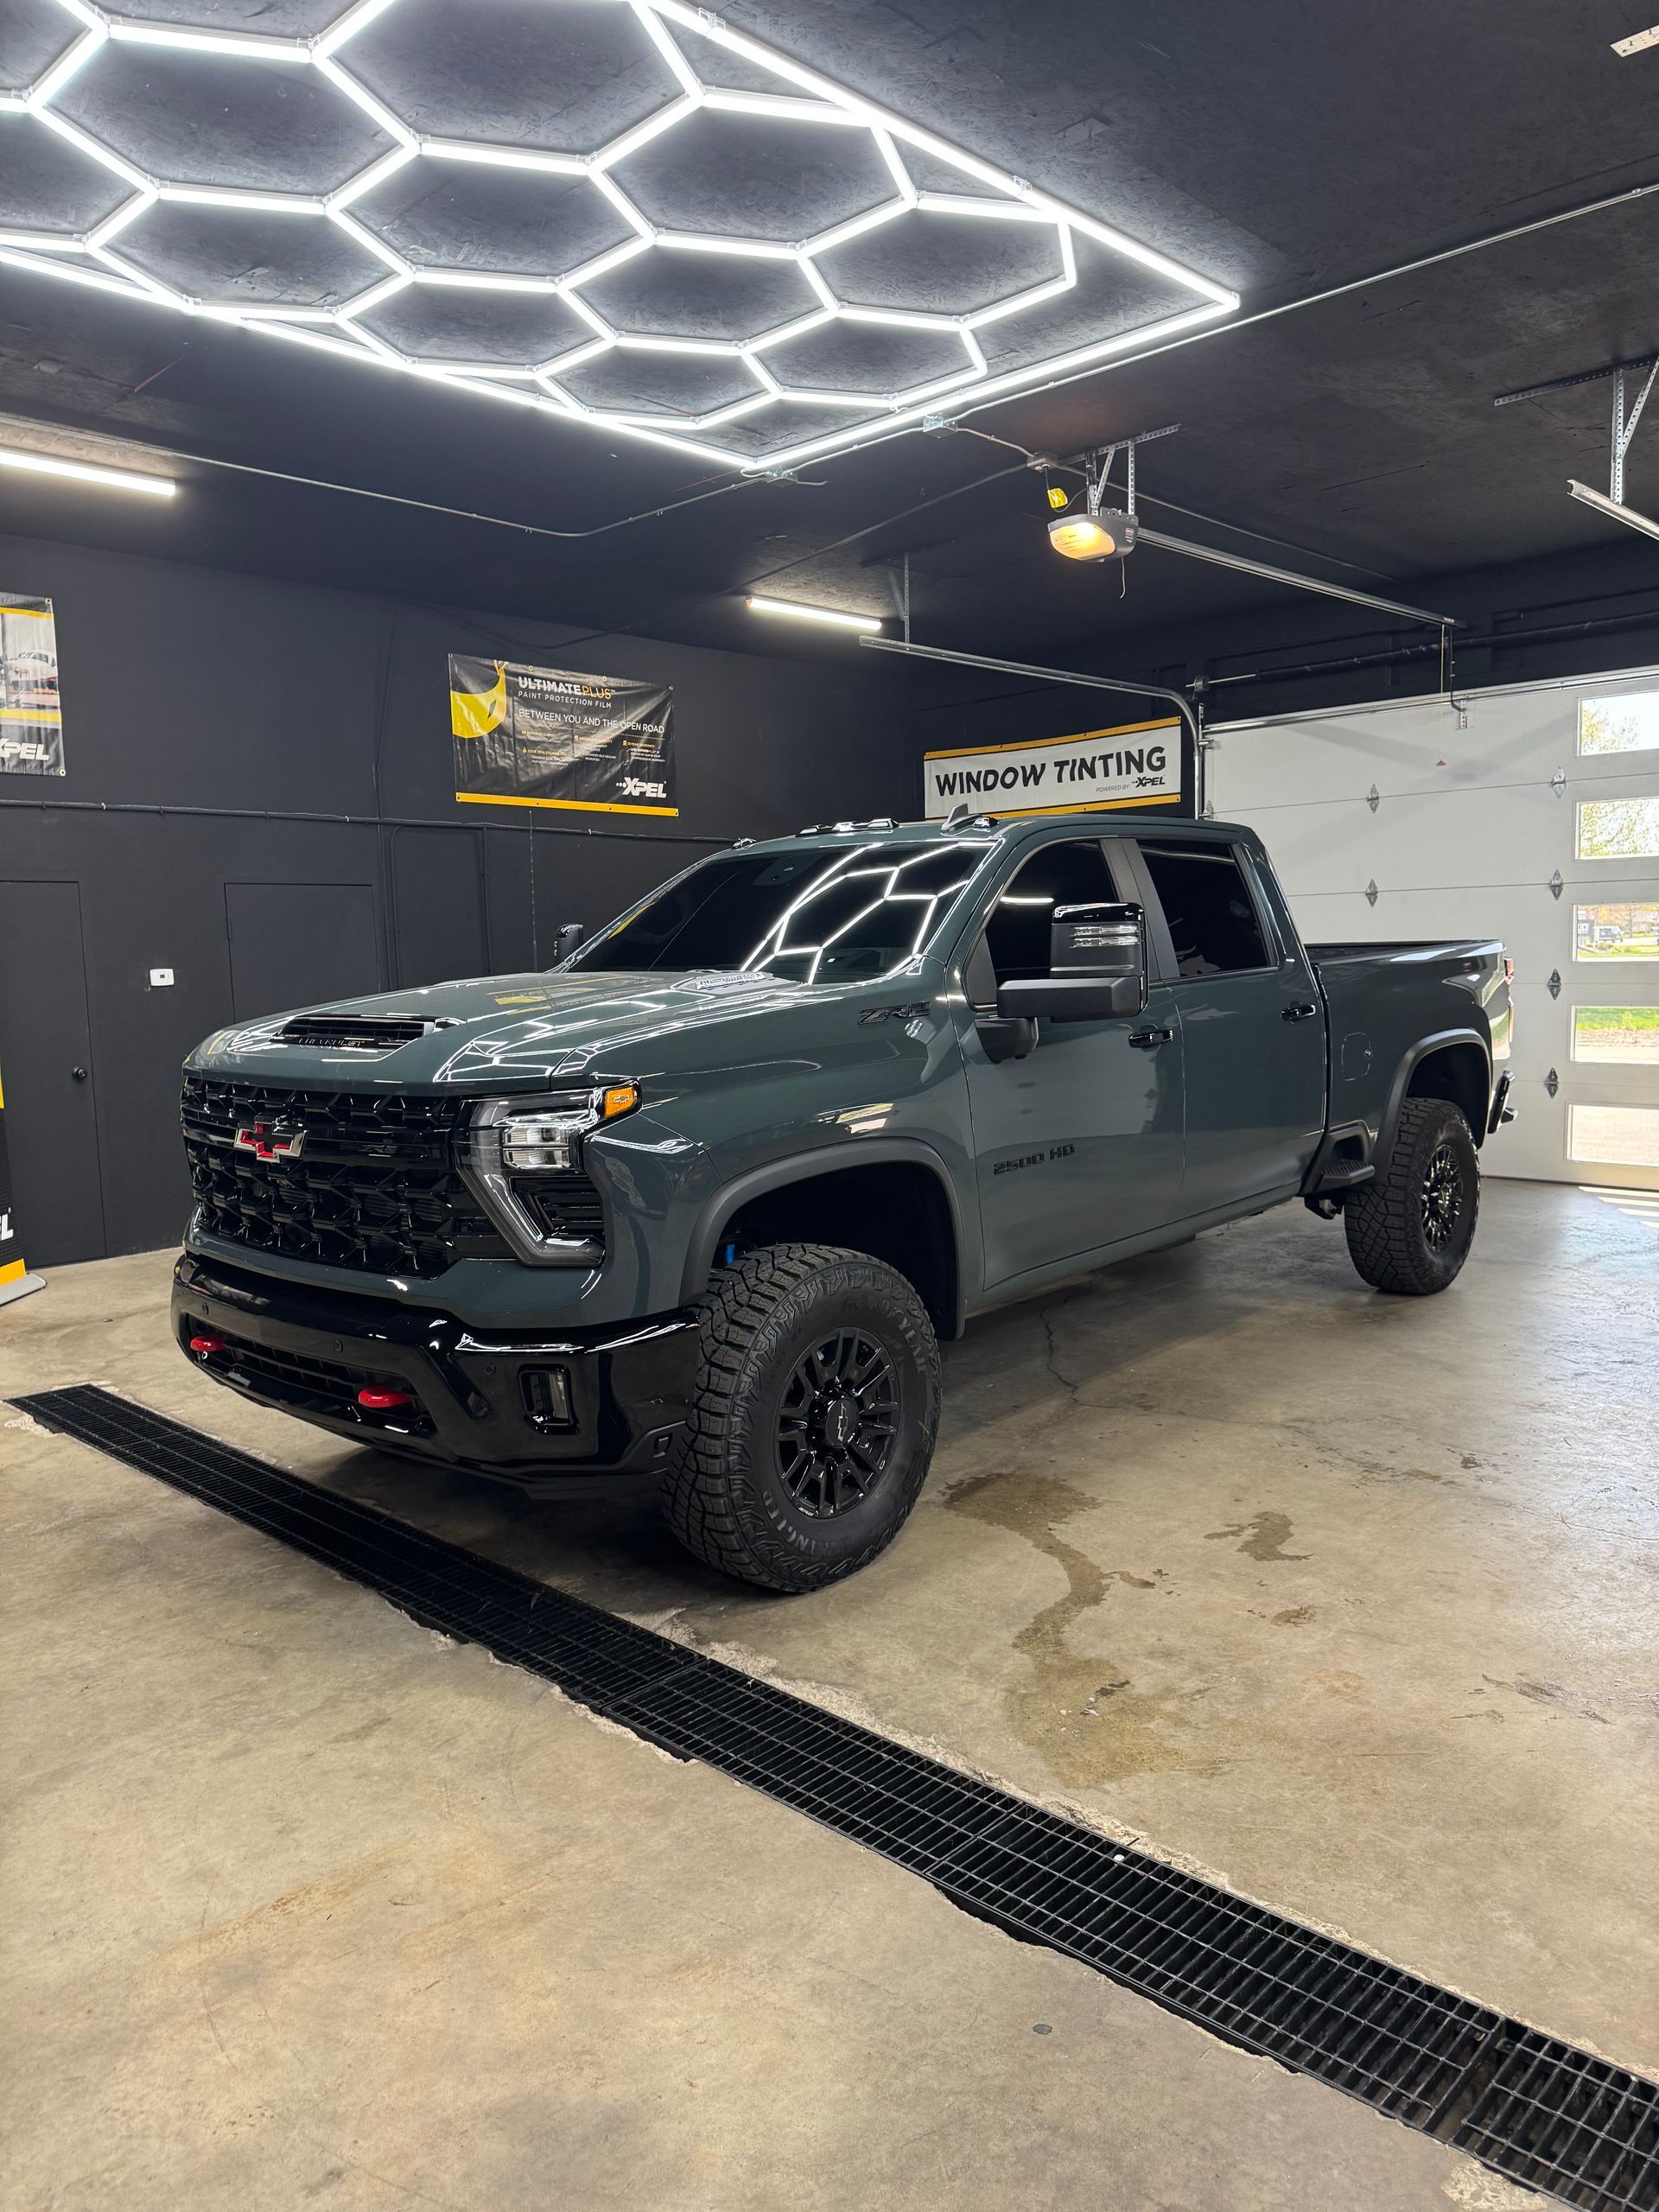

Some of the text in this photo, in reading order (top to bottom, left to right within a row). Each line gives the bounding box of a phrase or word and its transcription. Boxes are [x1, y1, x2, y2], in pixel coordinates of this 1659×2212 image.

[518, 691, 612, 709] PAINT PROTECTION FILM
[518, 709, 664, 734] BETWEEN YOU AND THE OPEN ROAD
[935, 746, 1166, 797] WINDOW TINTING
[1135, 776, 1166, 788] XPEL
[622, 778, 667, 798] XPEL
[994, 1143, 1076, 1175] 2500 HD
